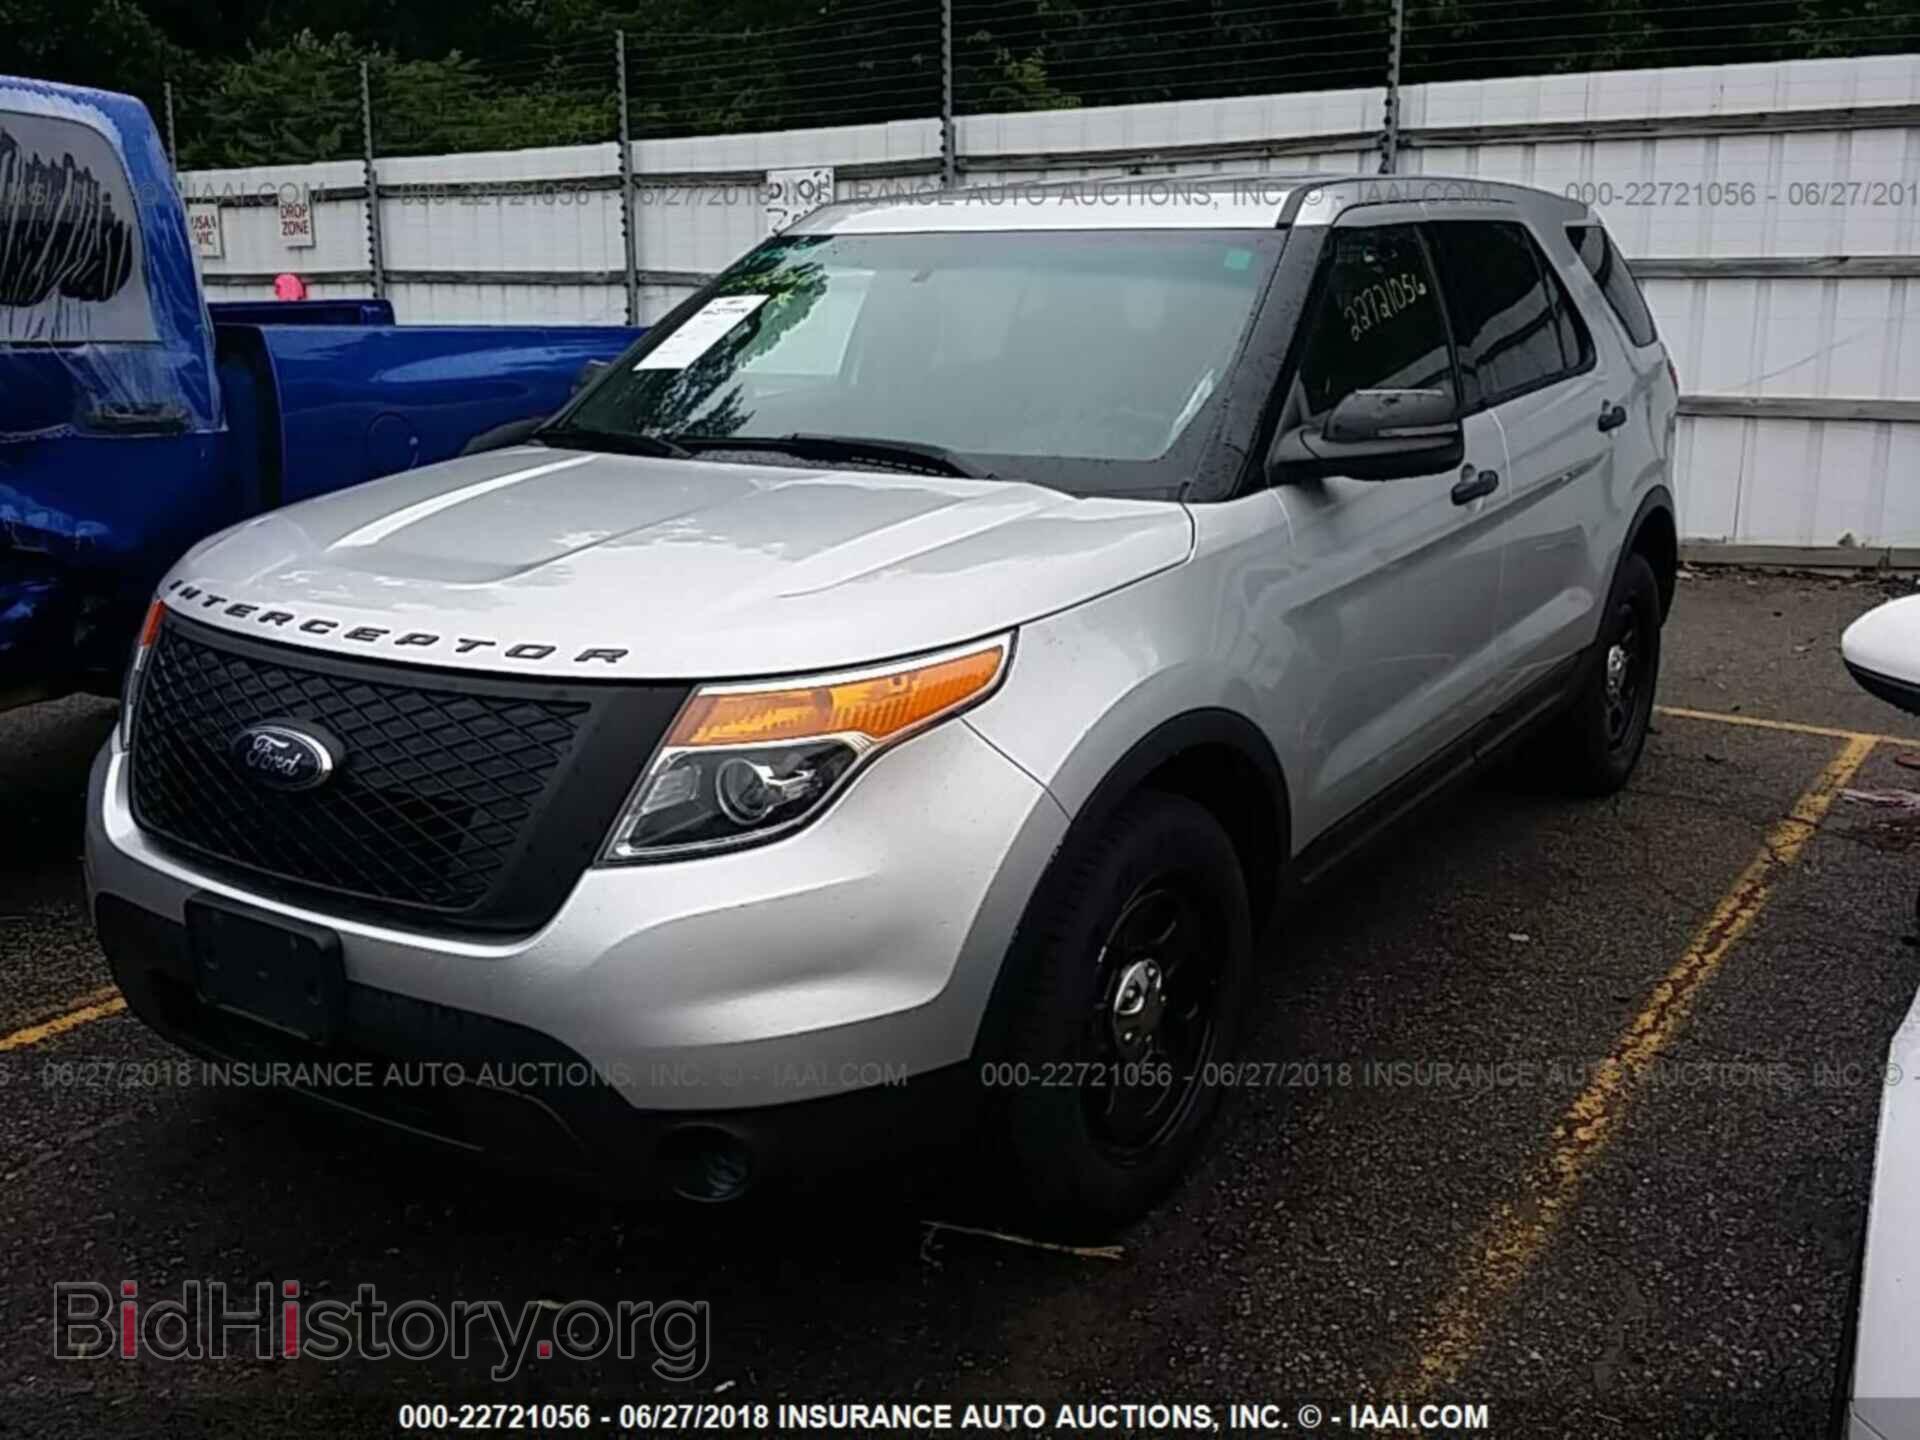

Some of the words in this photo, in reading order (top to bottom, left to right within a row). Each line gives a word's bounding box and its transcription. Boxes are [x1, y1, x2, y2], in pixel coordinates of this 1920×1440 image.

[280, 203, 309, 219] DROP
[281, 220, 310, 236] ZONE
[1343, 273, 1427, 342] 22721056
[168, 578, 631, 664] INTERCEPTOR
[246, 734, 303, 777] Ford
